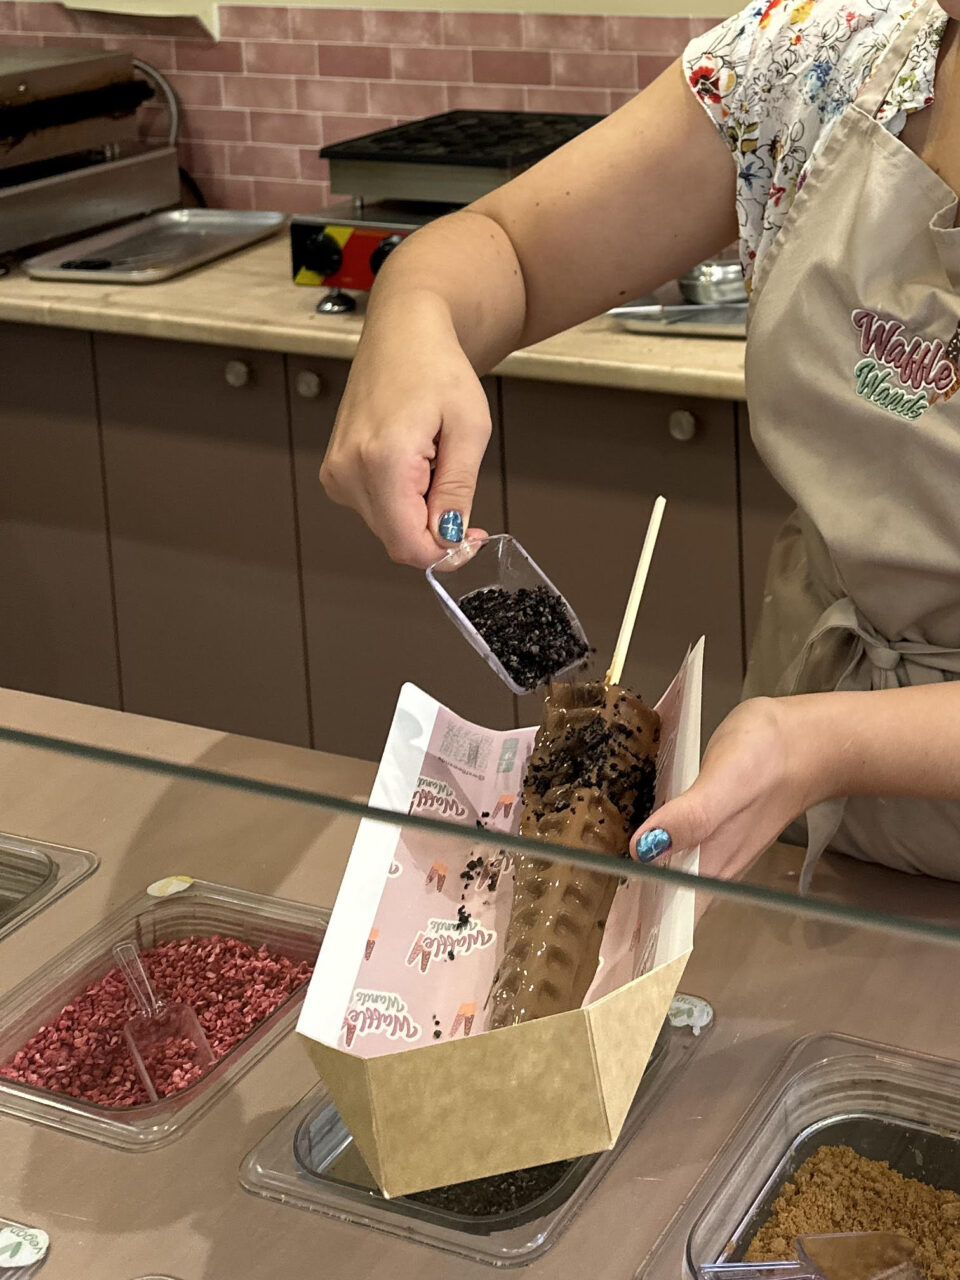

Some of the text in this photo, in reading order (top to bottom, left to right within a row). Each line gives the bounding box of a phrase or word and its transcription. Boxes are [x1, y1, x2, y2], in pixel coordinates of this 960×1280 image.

[852, 309, 956, 391] Waffle
[854, 358, 929, 419] Wands
[417, 776, 453, 797] Wand
[411, 788, 466, 817] Waffl
[423, 929, 494, 958] Waffle
[356, 991, 405, 1013] Wands
[350, 1007, 419, 1039] Waffle
